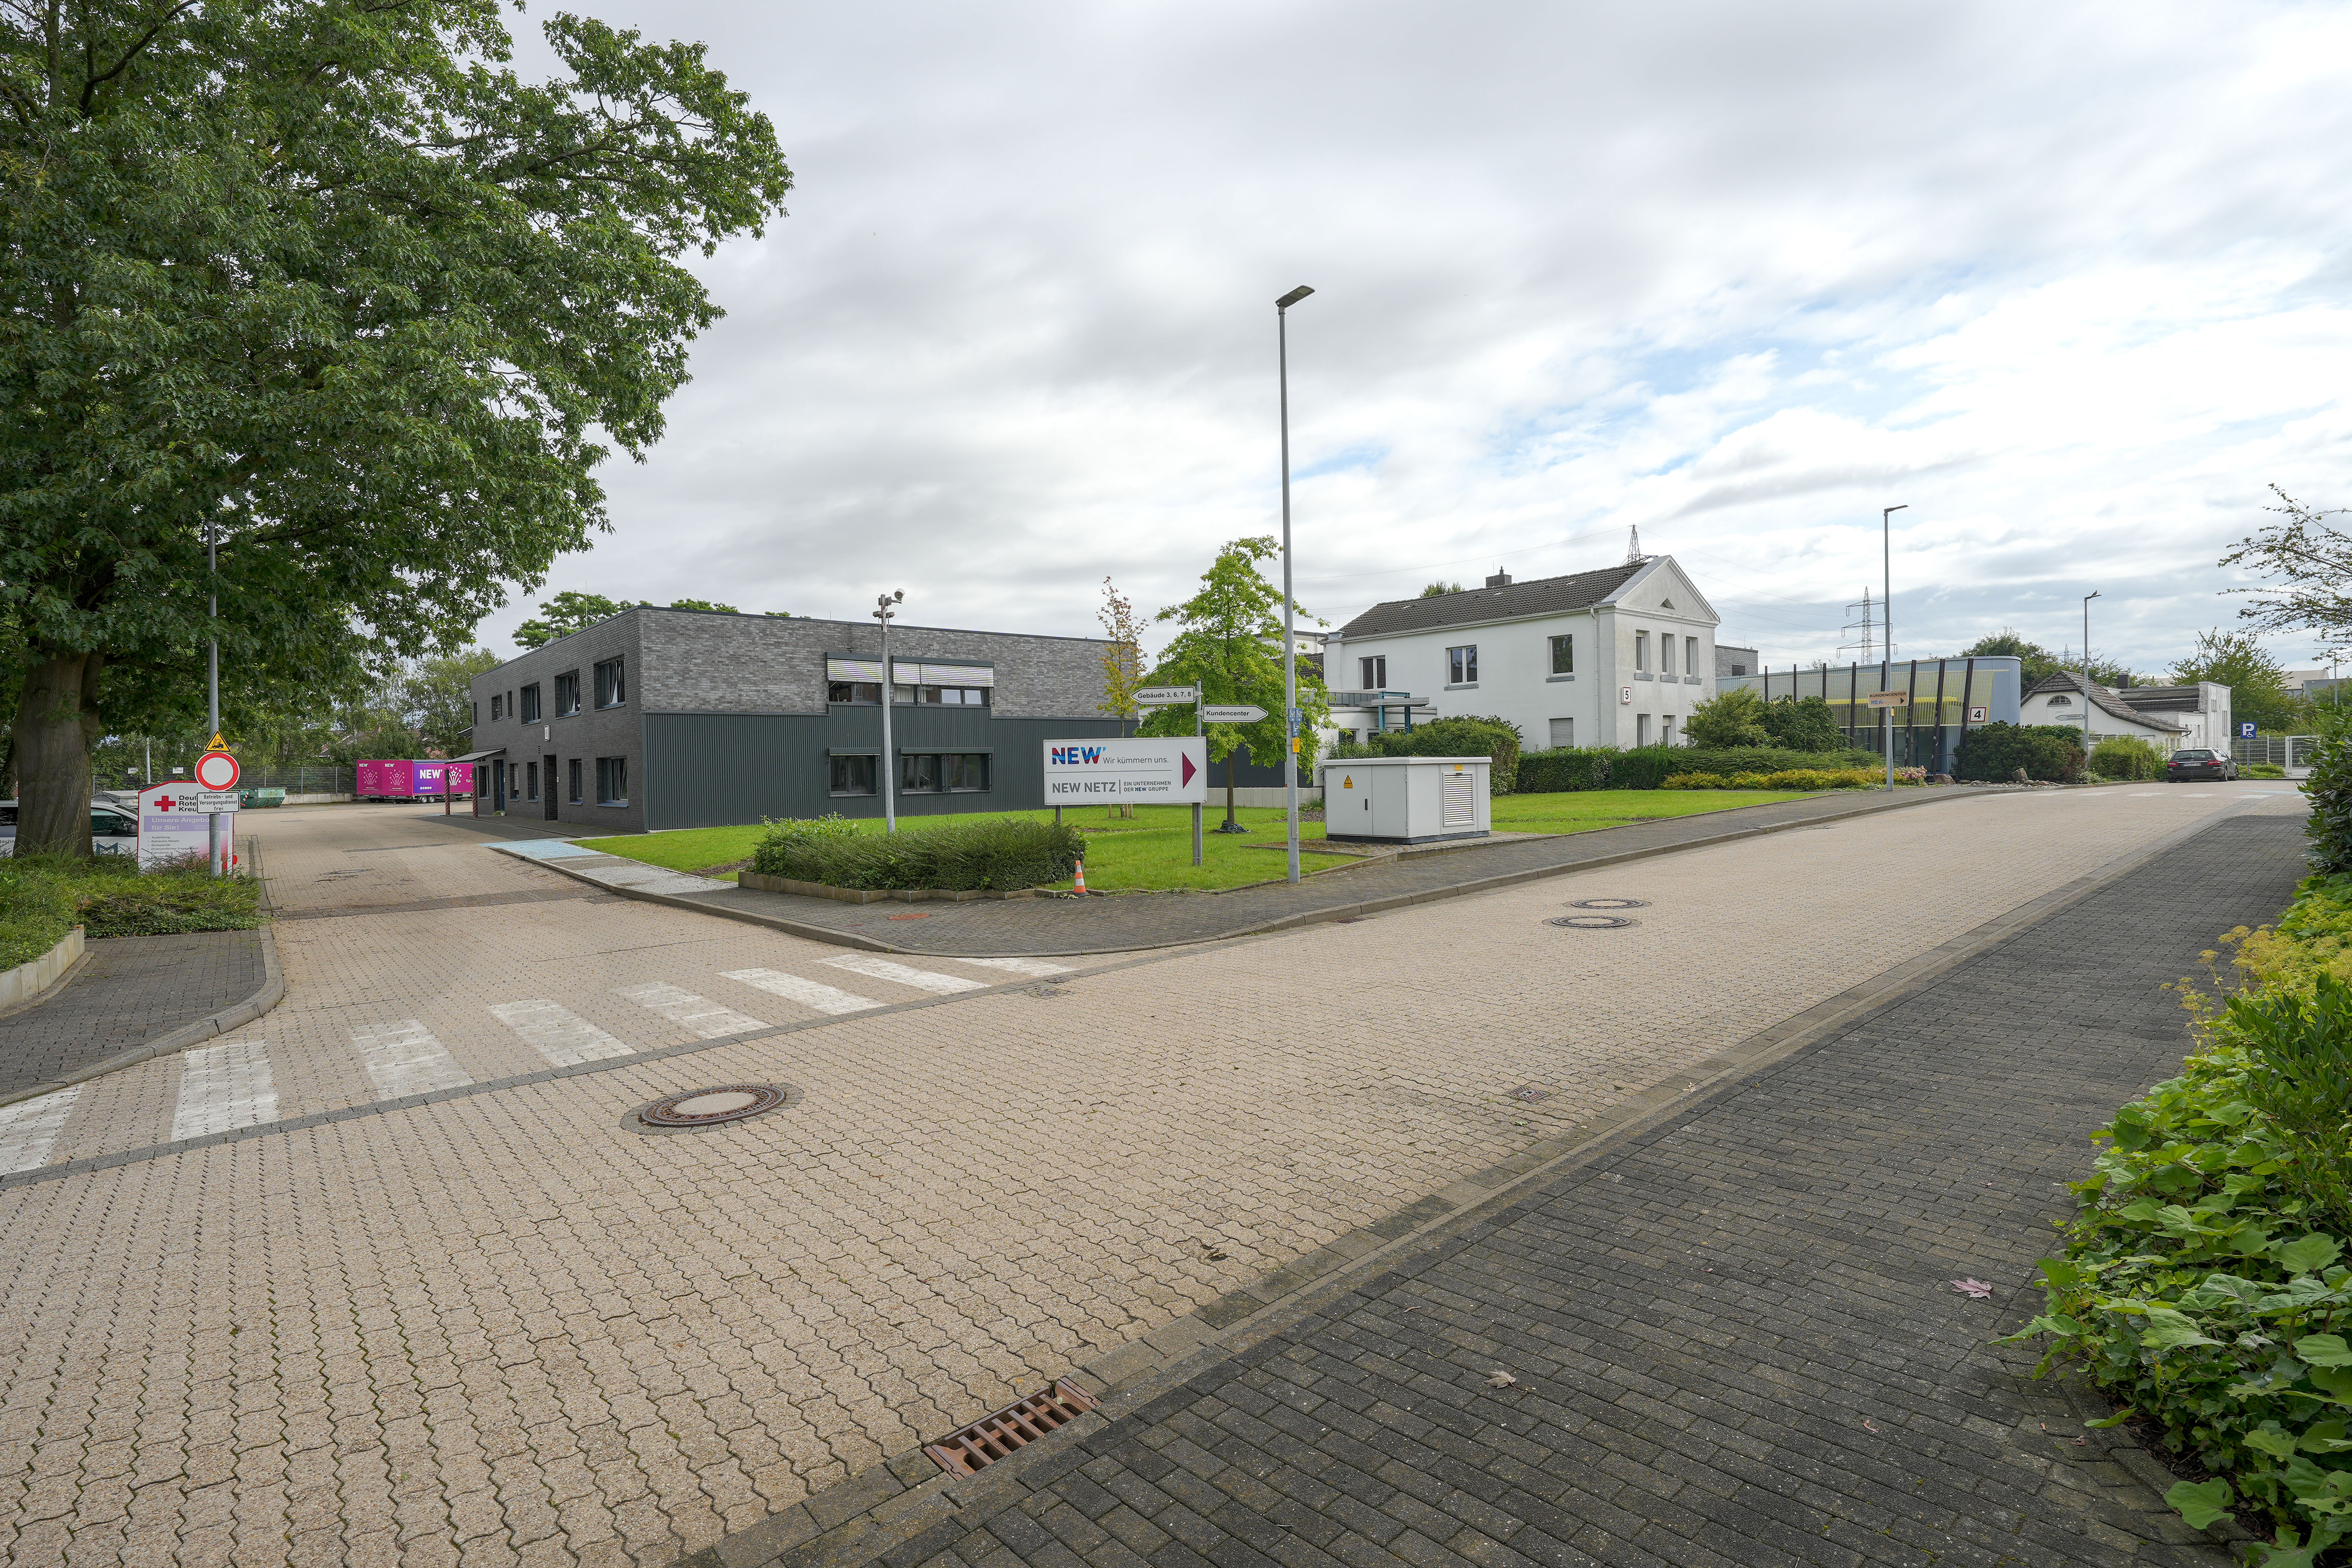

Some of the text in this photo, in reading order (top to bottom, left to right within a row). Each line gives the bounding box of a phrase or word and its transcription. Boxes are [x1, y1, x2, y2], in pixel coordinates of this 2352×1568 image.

[1625, 691, 1629, 699] 5
[1974, 710, 1981, 719] 4
[2242, 723, 2255, 735] P
[1052, 782, 1116, 793] NEW NETZ
